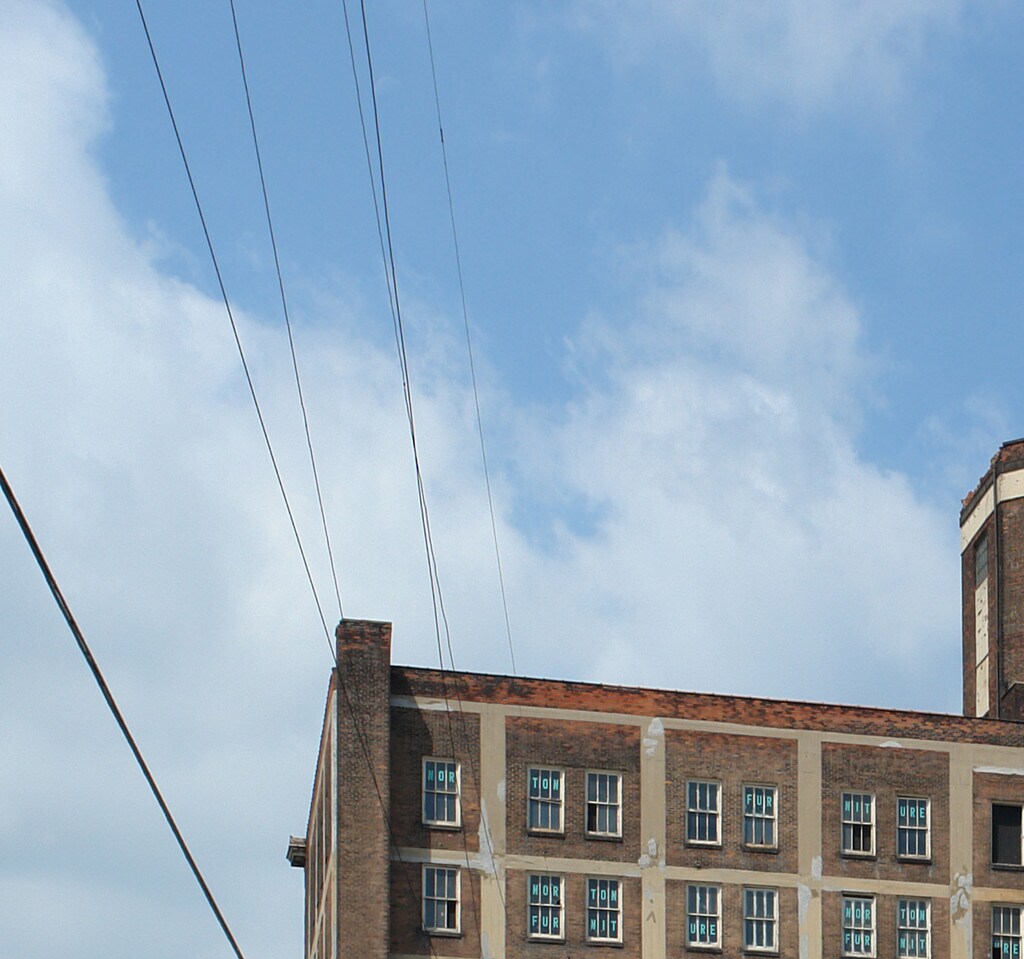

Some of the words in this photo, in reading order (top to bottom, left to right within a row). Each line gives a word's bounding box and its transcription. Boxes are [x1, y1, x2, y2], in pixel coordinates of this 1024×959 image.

[426, 770, 456, 783] NOR
[532, 776, 559, 790] TON
[746, 793, 773, 808] FUR
[844, 800, 870, 814] NIT
[900, 805, 926, 819] URE
[532, 884, 559, 897] NOR
[590, 888, 617, 902] TON
[532, 914, 559, 928] FUR
[589, 918, 617, 932] NIT
[844, 906, 870, 921] NOR
[900, 908, 926, 922] TON
[689, 922, 716, 937] URE
[844, 932, 870, 947] FUR
[899, 937, 925, 950] NIT
